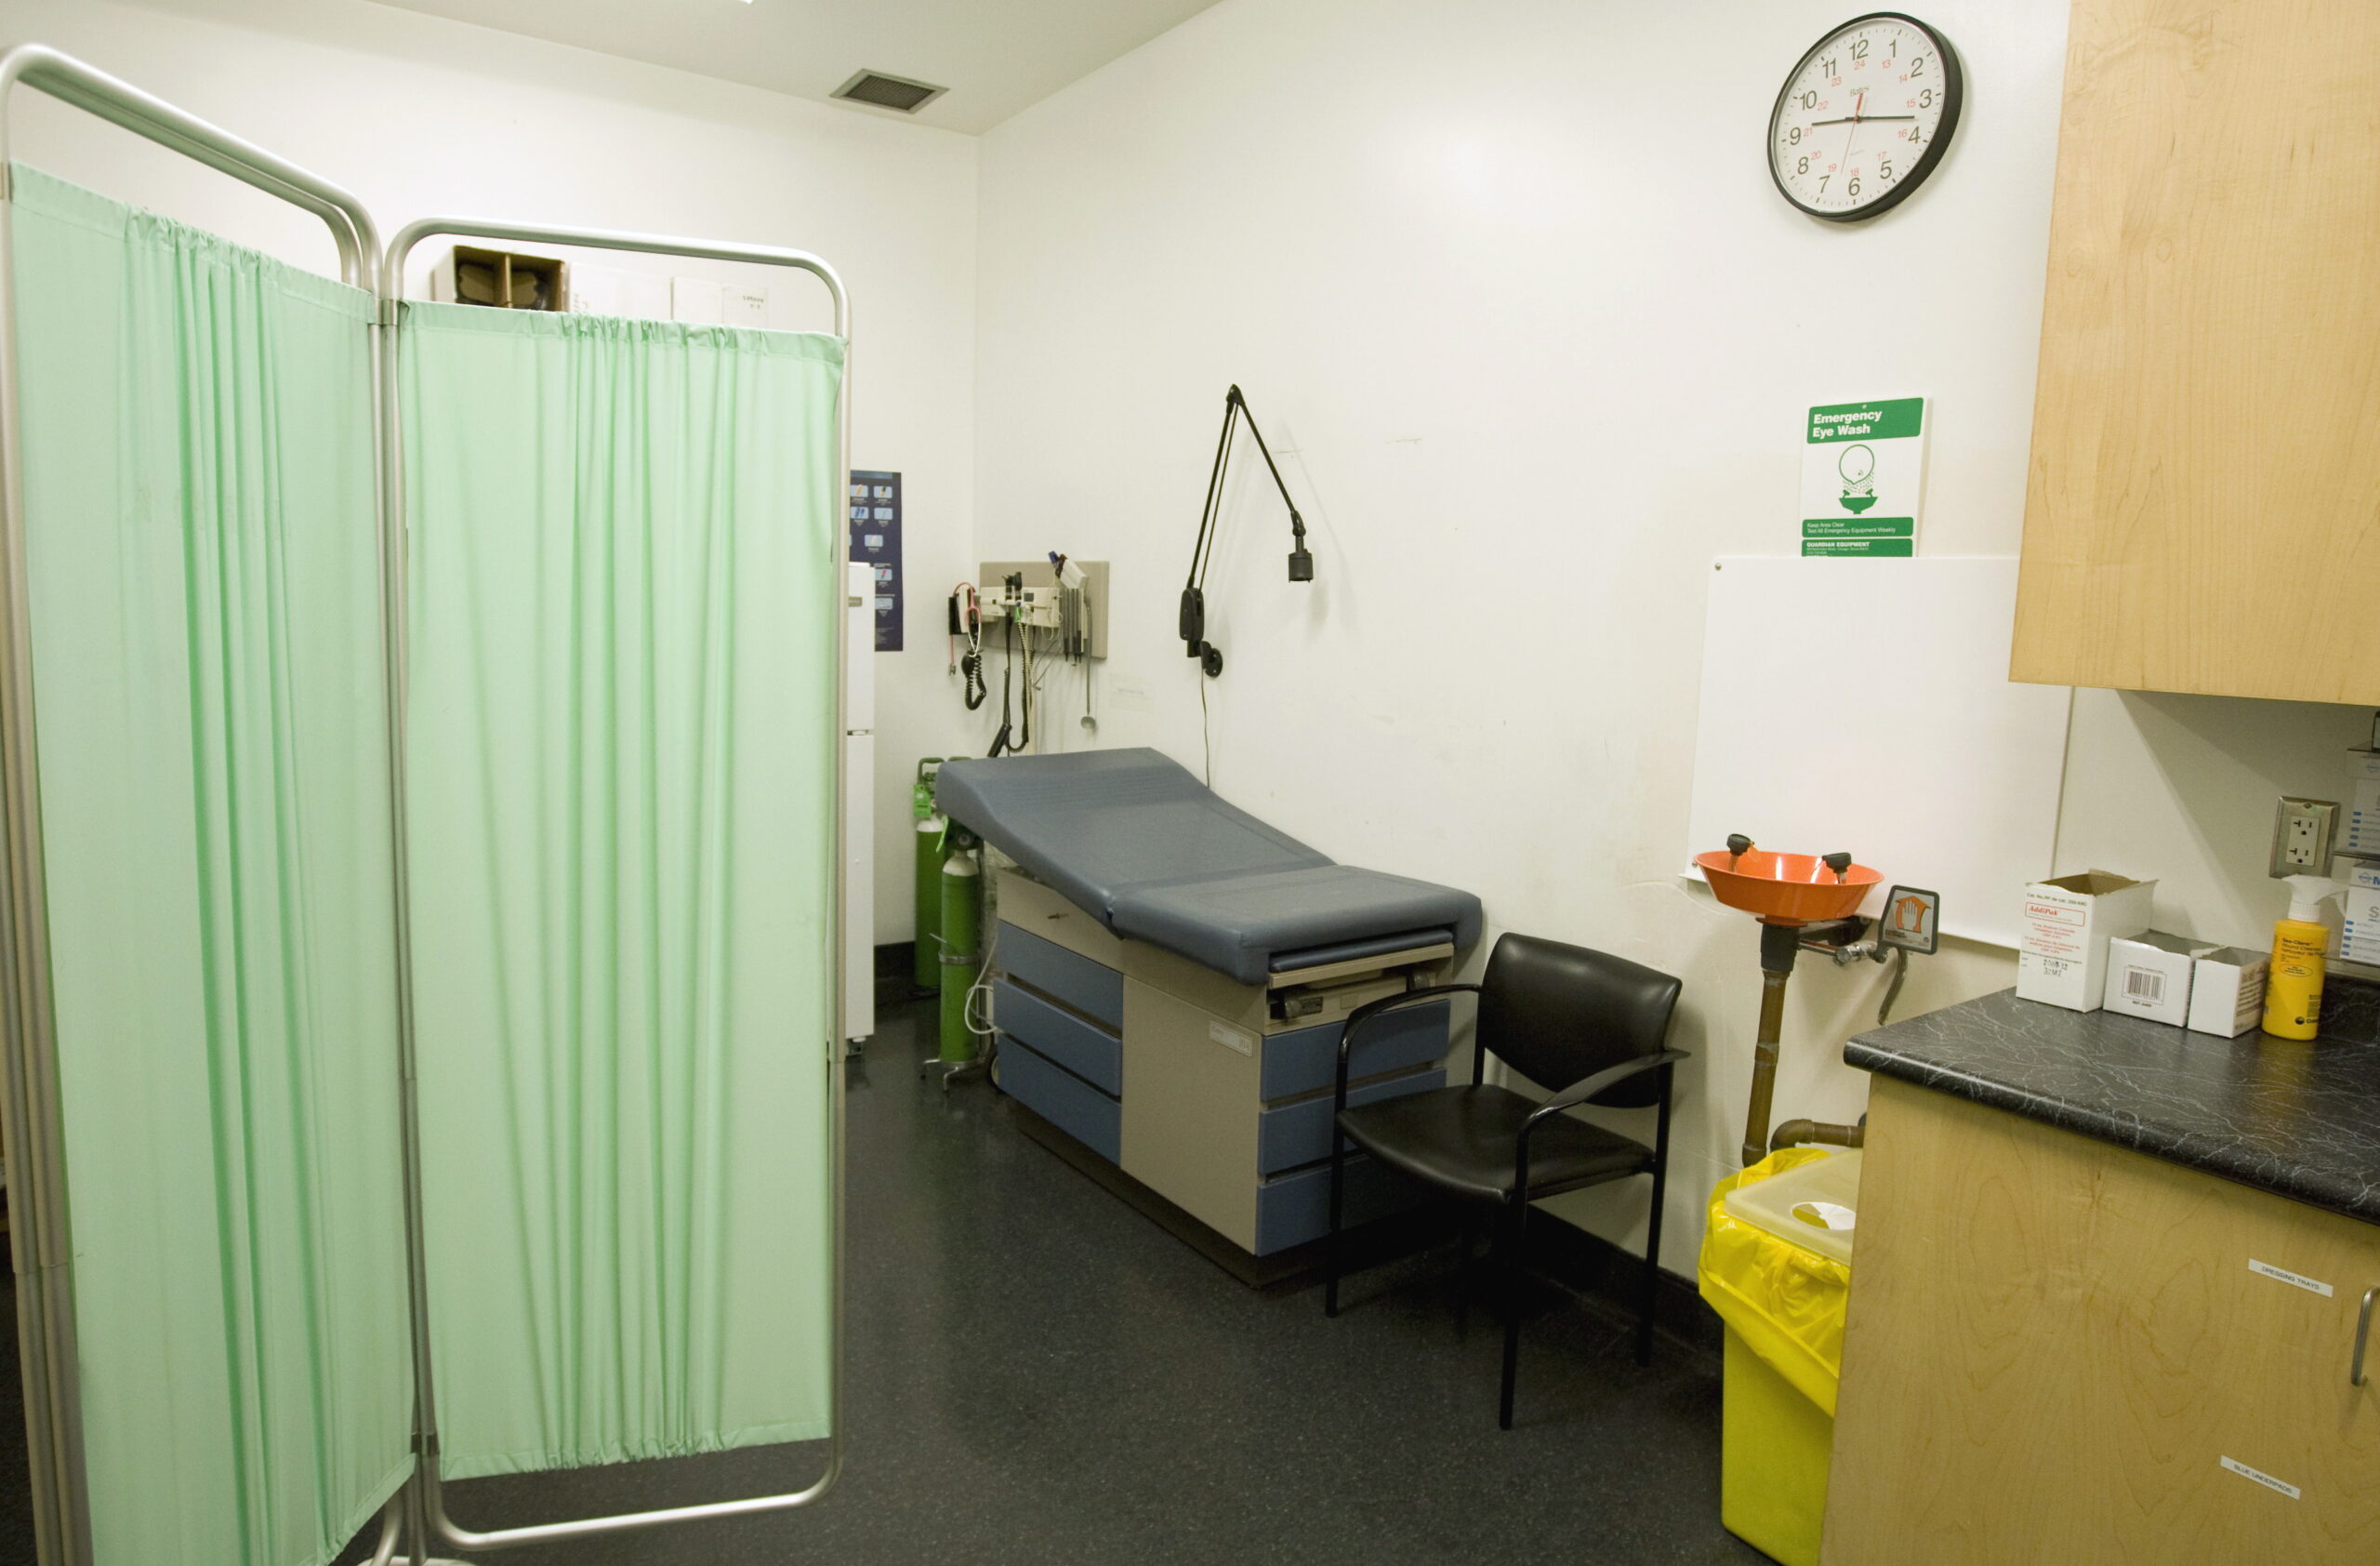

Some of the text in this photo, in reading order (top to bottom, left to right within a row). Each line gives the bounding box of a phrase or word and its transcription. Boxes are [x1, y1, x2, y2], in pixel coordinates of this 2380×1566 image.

[1849, 39, 1869, 60] 12
[1889, 39, 1897, 58] 1
[1822, 58, 1836, 79] 11
[1854, 60, 1866, 71] 24
[1882, 60, 1891, 69] 13
[1911, 57, 1924, 78] 2
[1831, 76, 1842, 86] 23
[1898, 74, 1908, 83] 14
[1799, 90, 1818, 111] 10
[1817, 101, 1829, 111] 22
[1907, 100, 1916, 108] 15
[1919, 88, 1932, 109] 3
[1790, 126, 1801, 145] 9
[1803, 127, 1813, 137] 21
[1897, 129, 1908, 139] 16
[1908, 126, 1921, 144] 4
[1810, 151, 1822, 160] 20
[1877, 152, 1887, 160] 17
[1797, 156, 1808, 175] 8
[1828, 164, 1837, 172] 19
[1850, 167, 1859, 177] 18
[1880, 160, 1893, 179] 5
[1818, 175, 1831, 193] 7
[1848, 177, 1860, 196] 6
[1813, 410, 1883, 424] Emergency
[1812, 423, 1871, 440] Eye Wash
[2029, 906, 2058, 916] AddiPak
[2261, 1266, 2320, 1290] DRESSING TRAYS
